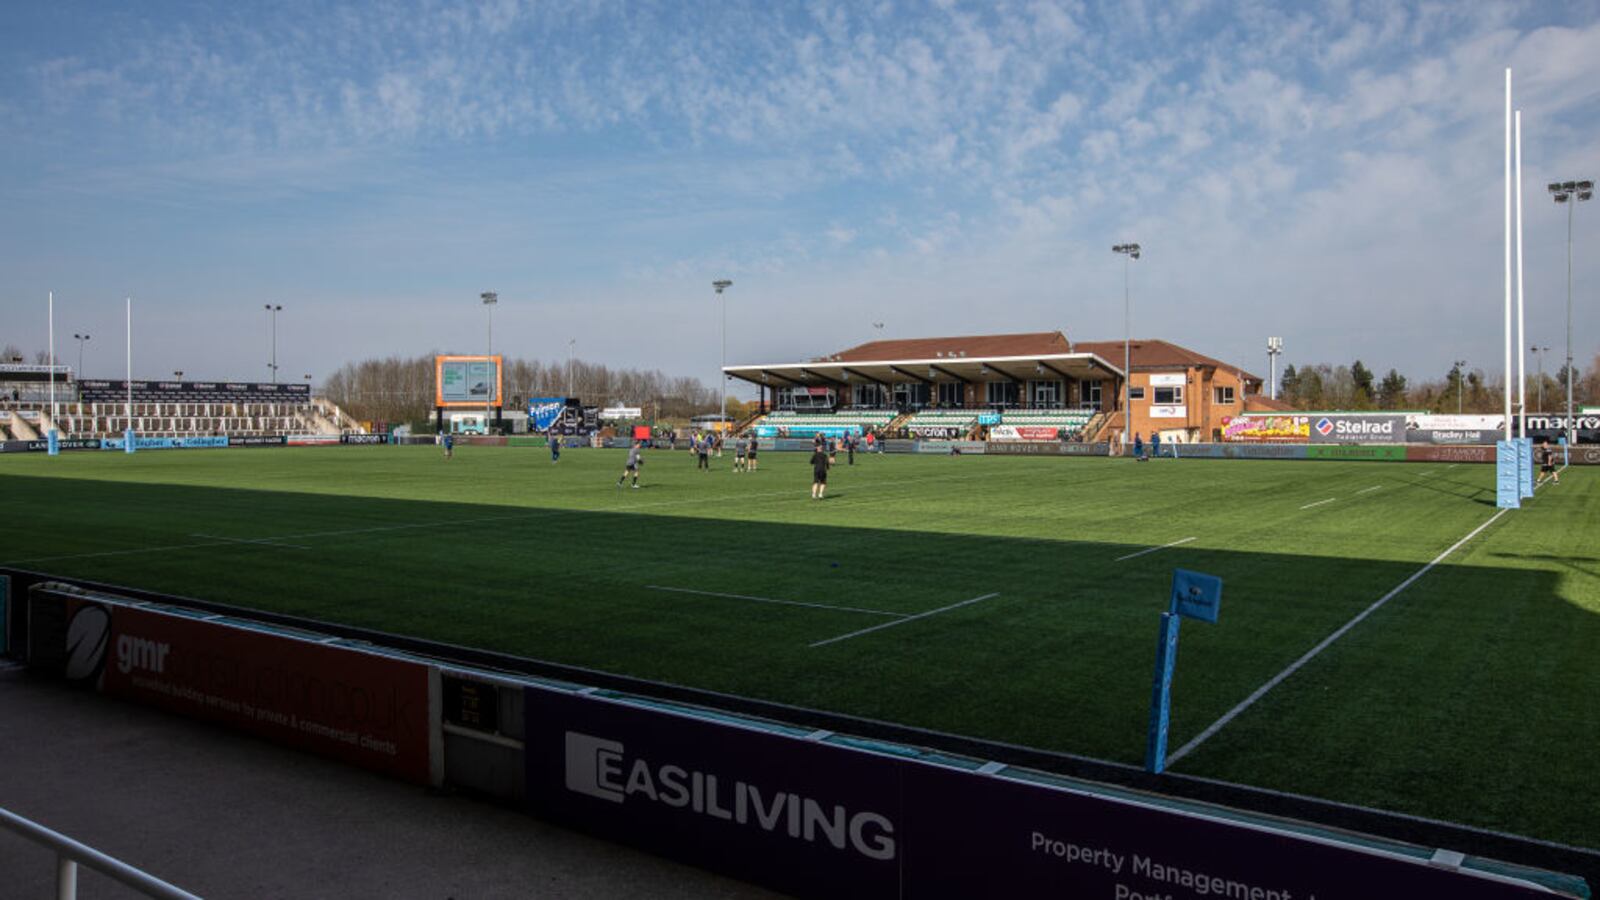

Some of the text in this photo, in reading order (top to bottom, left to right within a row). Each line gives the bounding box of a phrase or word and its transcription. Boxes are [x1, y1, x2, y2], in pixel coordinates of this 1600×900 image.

[1335, 419, 1393, 434] Stelrad
[1432, 431, 1464, 440] Bradley
[116, 632, 170, 674] gmr
[256, 707, 289, 727] private
[299, 718, 359, 746] commercial
[360, 732, 398, 756] clients
[596, 748, 897, 861] EASILIVING
[1030, 831, 1292, 900] Property Management
